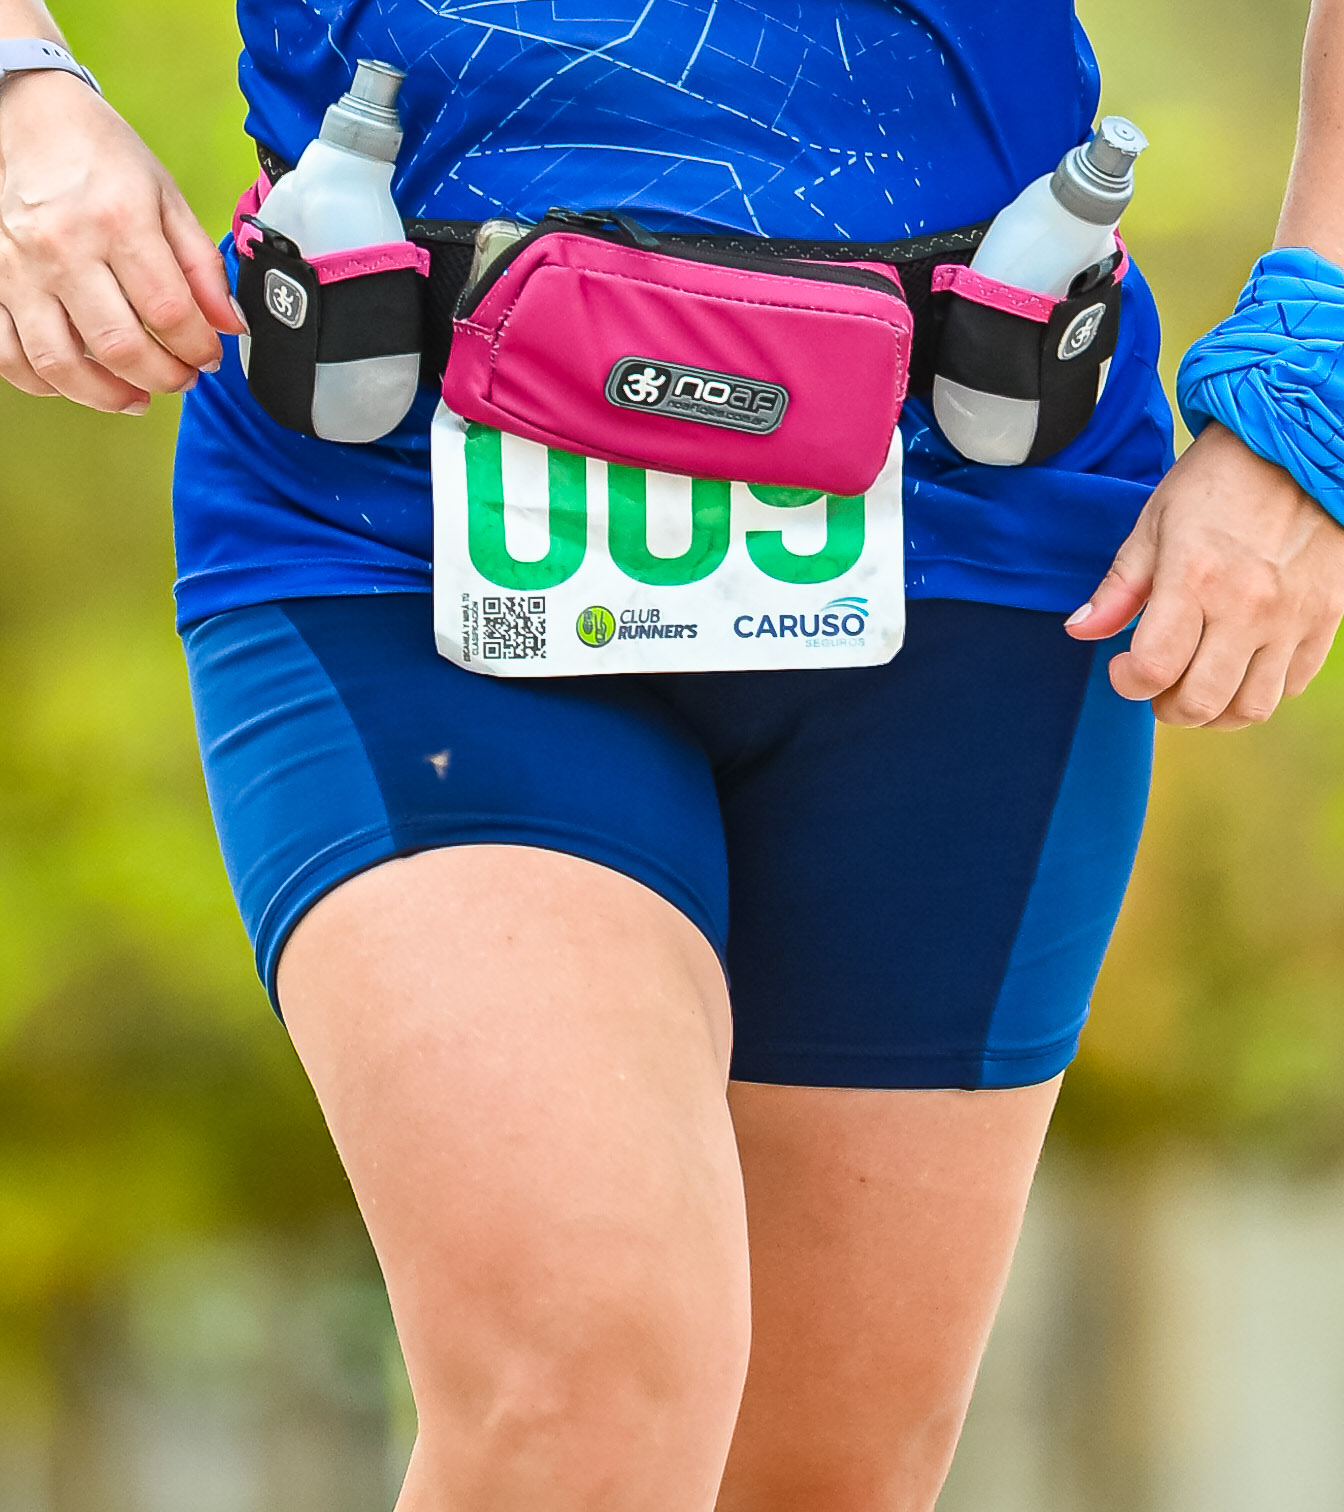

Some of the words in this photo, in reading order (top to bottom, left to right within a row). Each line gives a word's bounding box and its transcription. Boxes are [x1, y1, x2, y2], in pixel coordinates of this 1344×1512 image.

[620, 609, 661, 624] CLUB
[618, 624, 698, 640] RUNNER'S
[733, 613, 865, 638] CARUSO
[805, 637, 865, 648] SEGUROS
